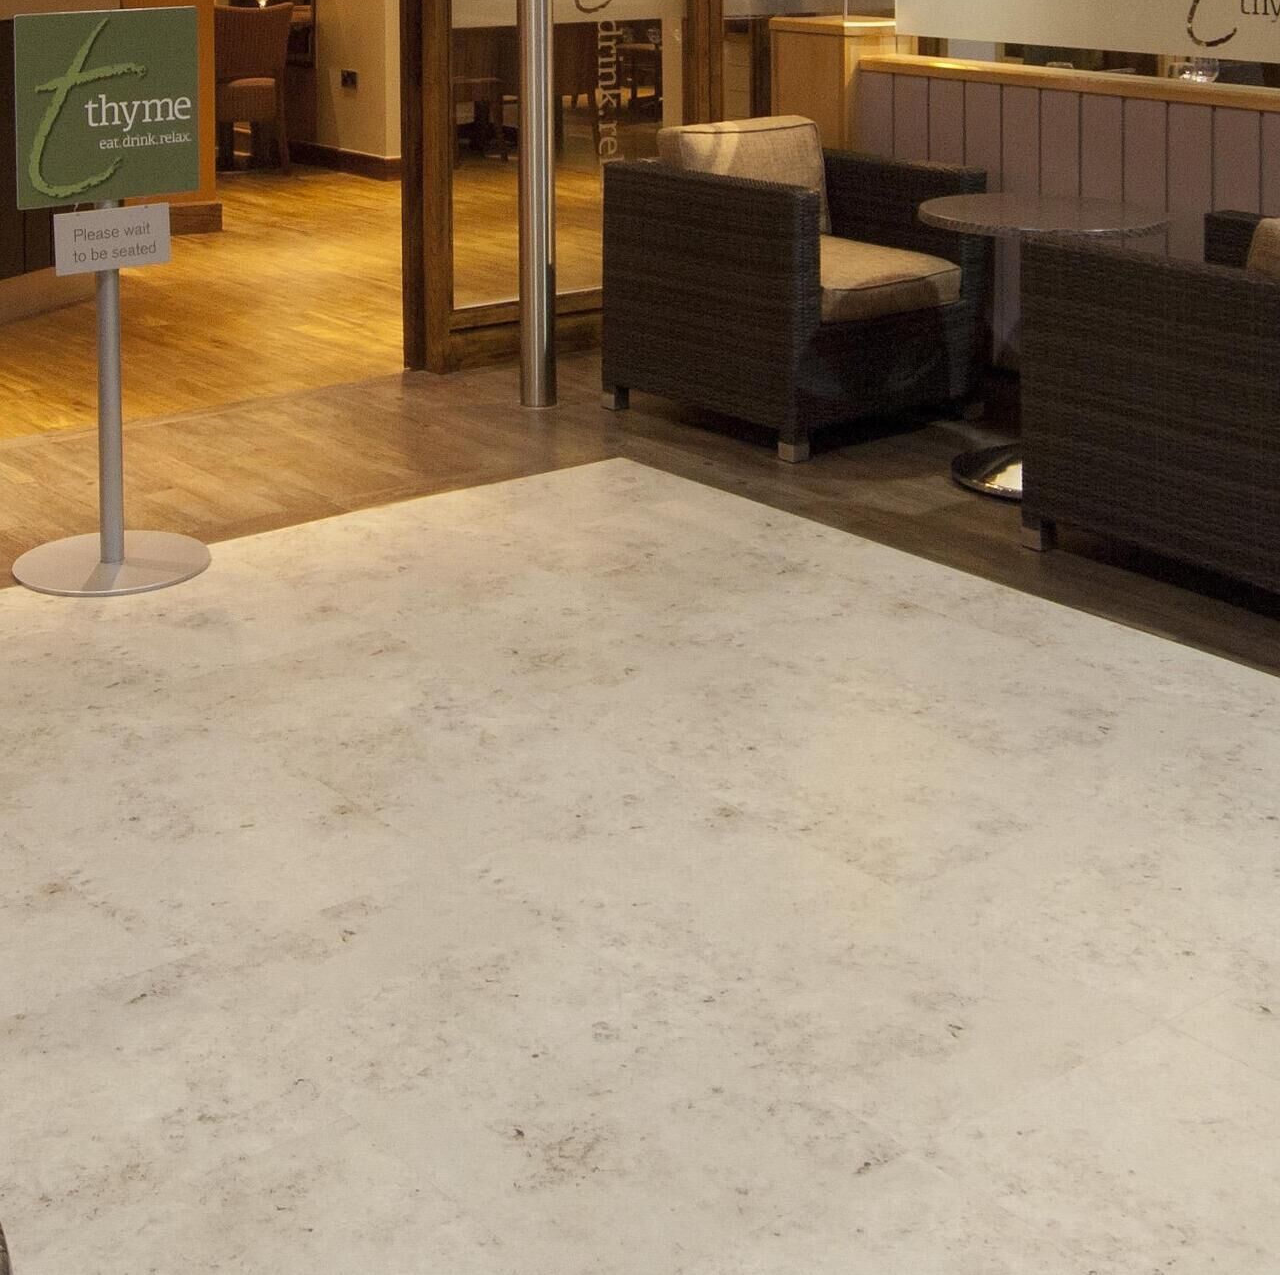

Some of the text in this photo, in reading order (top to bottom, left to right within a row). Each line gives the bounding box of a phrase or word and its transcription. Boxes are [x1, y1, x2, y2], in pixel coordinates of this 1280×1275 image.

[84, 94, 192, 132] thyme
[73, 222, 151, 243] Please wait
[73, 240, 157, 263] to be seated
